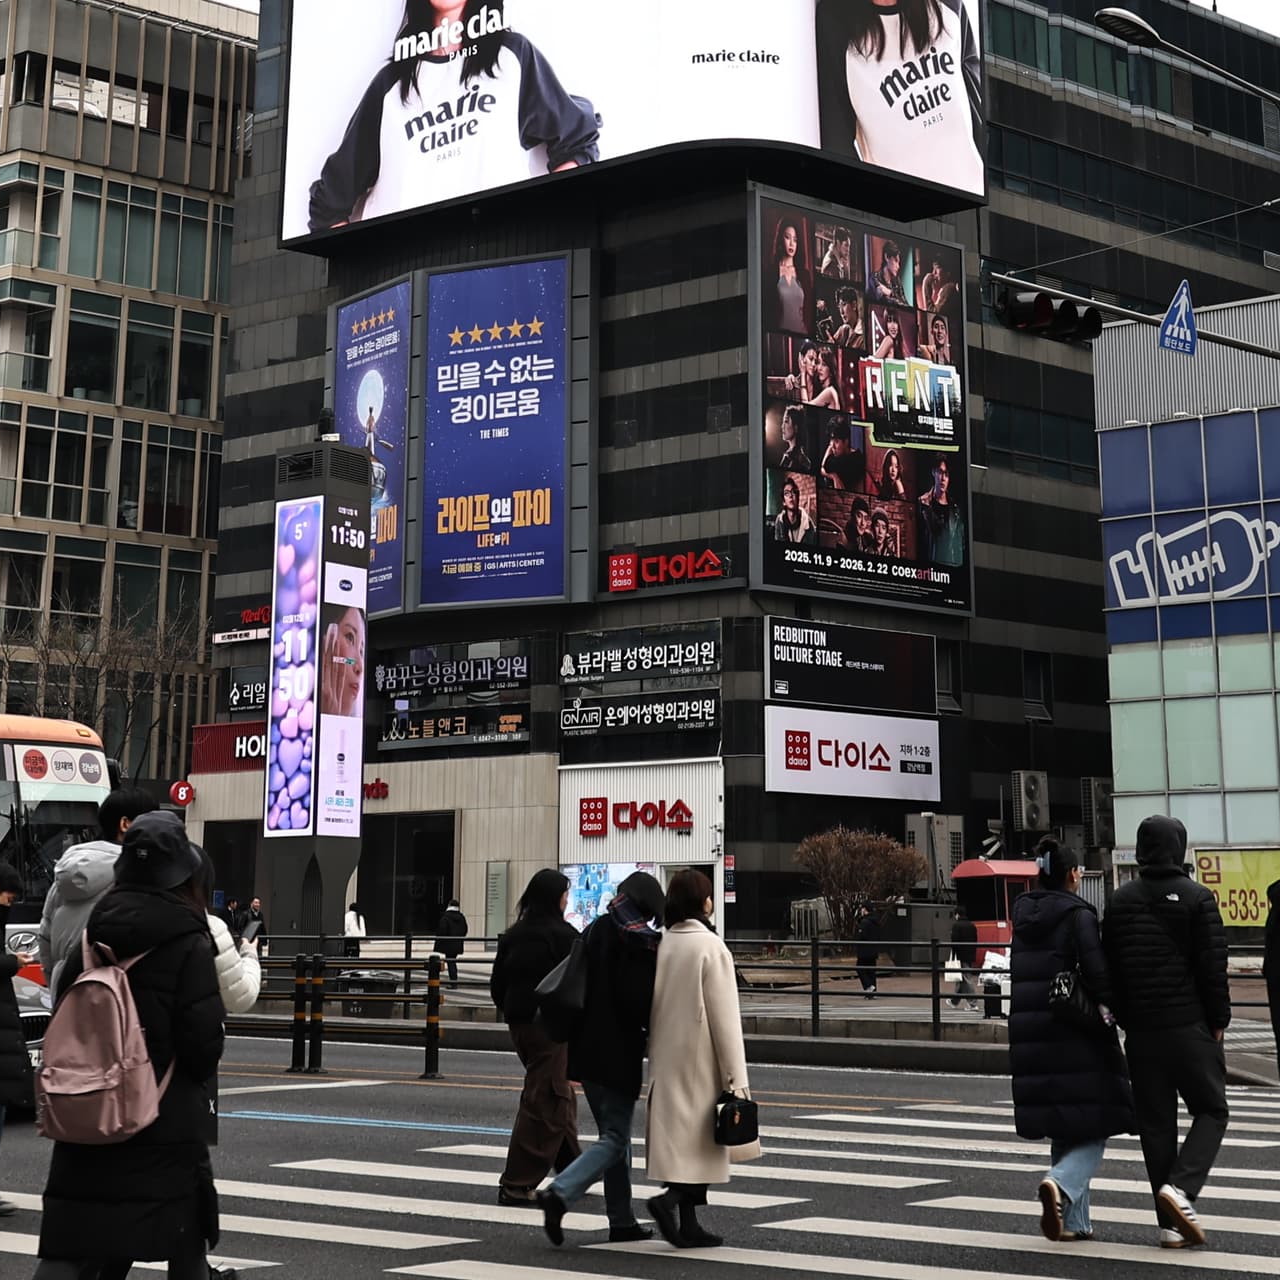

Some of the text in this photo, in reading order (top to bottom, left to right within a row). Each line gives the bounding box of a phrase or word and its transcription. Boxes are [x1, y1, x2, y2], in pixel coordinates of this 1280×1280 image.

[394, 17, 464, 62] marie
[692, 49, 780, 65] marie claire
[880, 46, 954, 108] marie
[404, 84, 496, 141] marie
[903, 83, 951, 121] claire
[420, 118, 478, 153] claire
[1164, 337, 1192, 352] 횡단보도
[437, 354, 555, 393] 믿을 수 없는
[450, 388, 540, 424] 경이로움
[865, 364, 953, 417] RENT
[480, 427, 509, 440] THE TIMES
[437, 493, 490, 534] 라이프
[512, 487, 551, 528] 파이
[331, 525, 365, 549] 11:50
[477, 533, 495, 548] LIFE
[501, 531, 510, 546] PI
[641, 549, 723, 582] 다이소
[785, 549, 812, 565] 2025.
[813, 553, 825, 566] 11.
[825, 555, 832, 567] 9
[840, 557, 866, 572] 2026.
[867, 561, 876, 573] 2.
[877, 563, 889, 575] 22
[891, 565, 951, 585] coexartium
[612, 577, 632, 587] daiso
[281, 627, 308, 663] 11
[774, 625, 827, 647] REDBUTTON
[774, 644, 843, 668] CULTURE STAGE
[408, 715, 467, 739] 노블앤코
[564, 709, 599, 725] ON AIR
[788, 755, 808, 766] daiso
[817, 739, 892, 772] 다이소
[582, 822, 602, 831] daiso
[613, 799, 694, 830] 다이소
